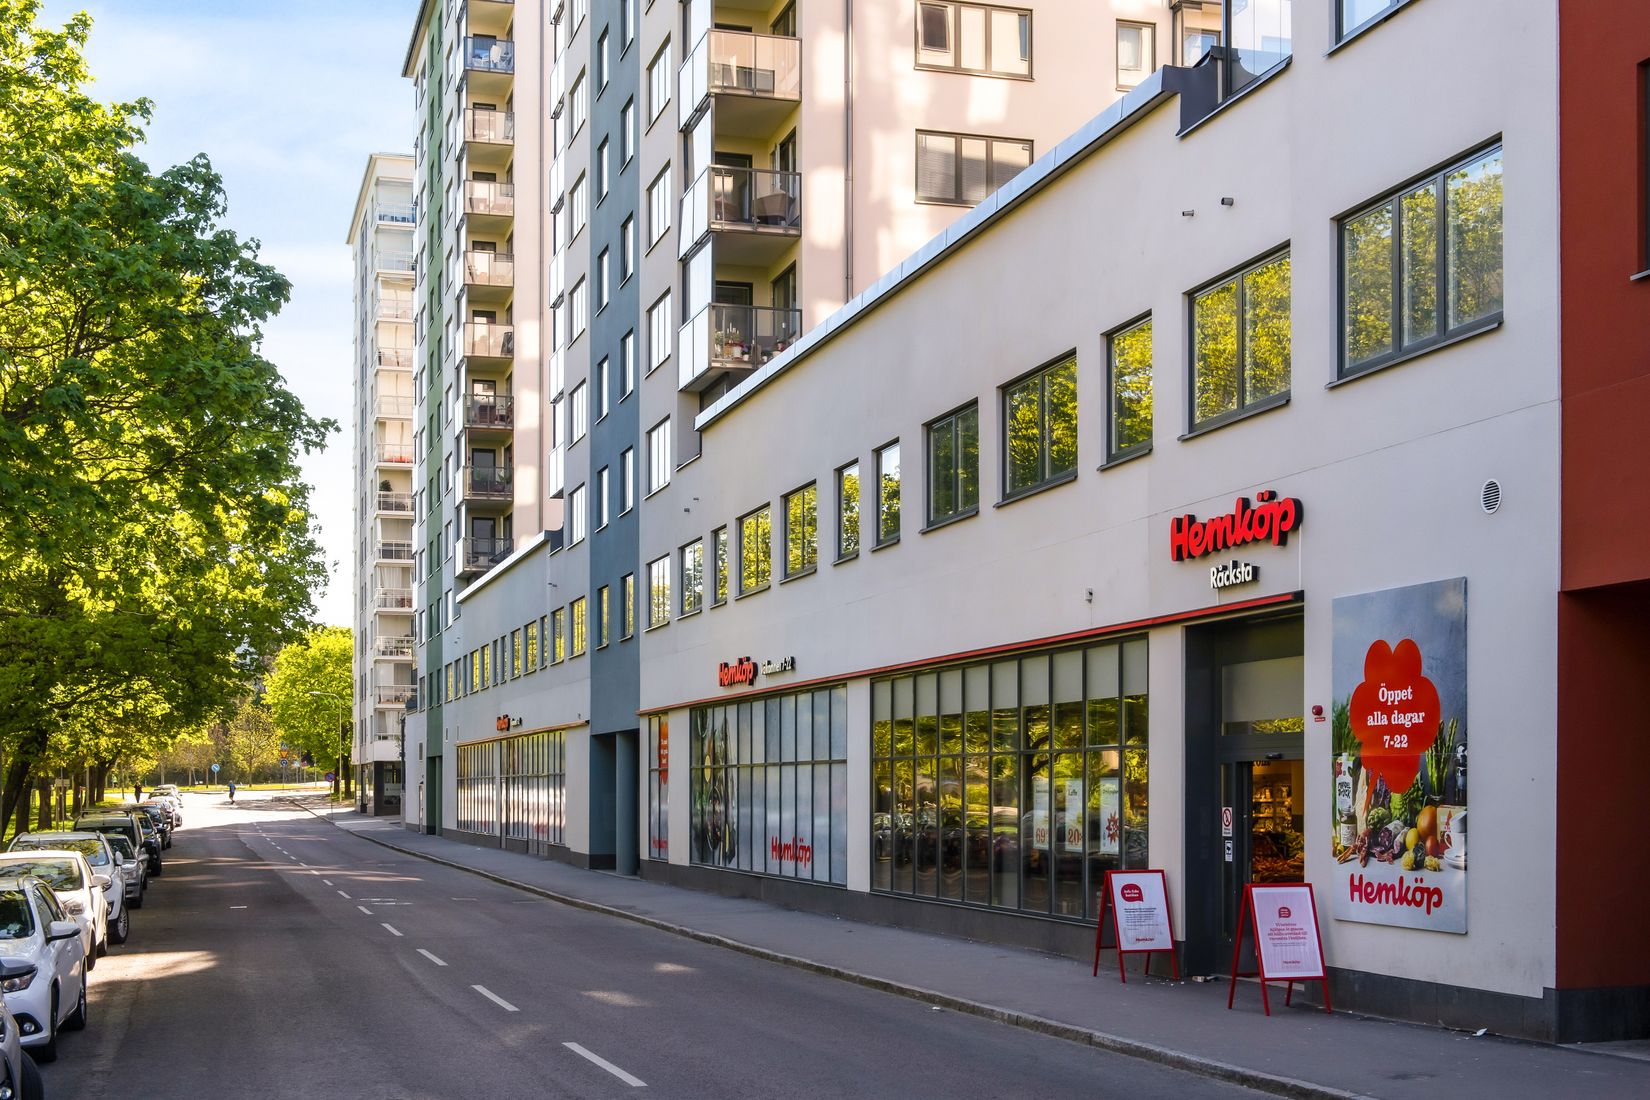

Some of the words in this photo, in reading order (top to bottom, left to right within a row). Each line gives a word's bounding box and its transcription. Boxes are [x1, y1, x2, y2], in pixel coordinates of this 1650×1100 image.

[1170, 489, 1299, 562] Hemköp
[1210, 560, 1254, 589] Råcksta
[718, 656, 756, 687] Hemköp
[1378, 682, 1413, 706] Öppet
[1367, 711, 1388, 726] alla
[1391, 709, 1425, 728] dagar
[1349, 873, 1443, 916] Hemköp
